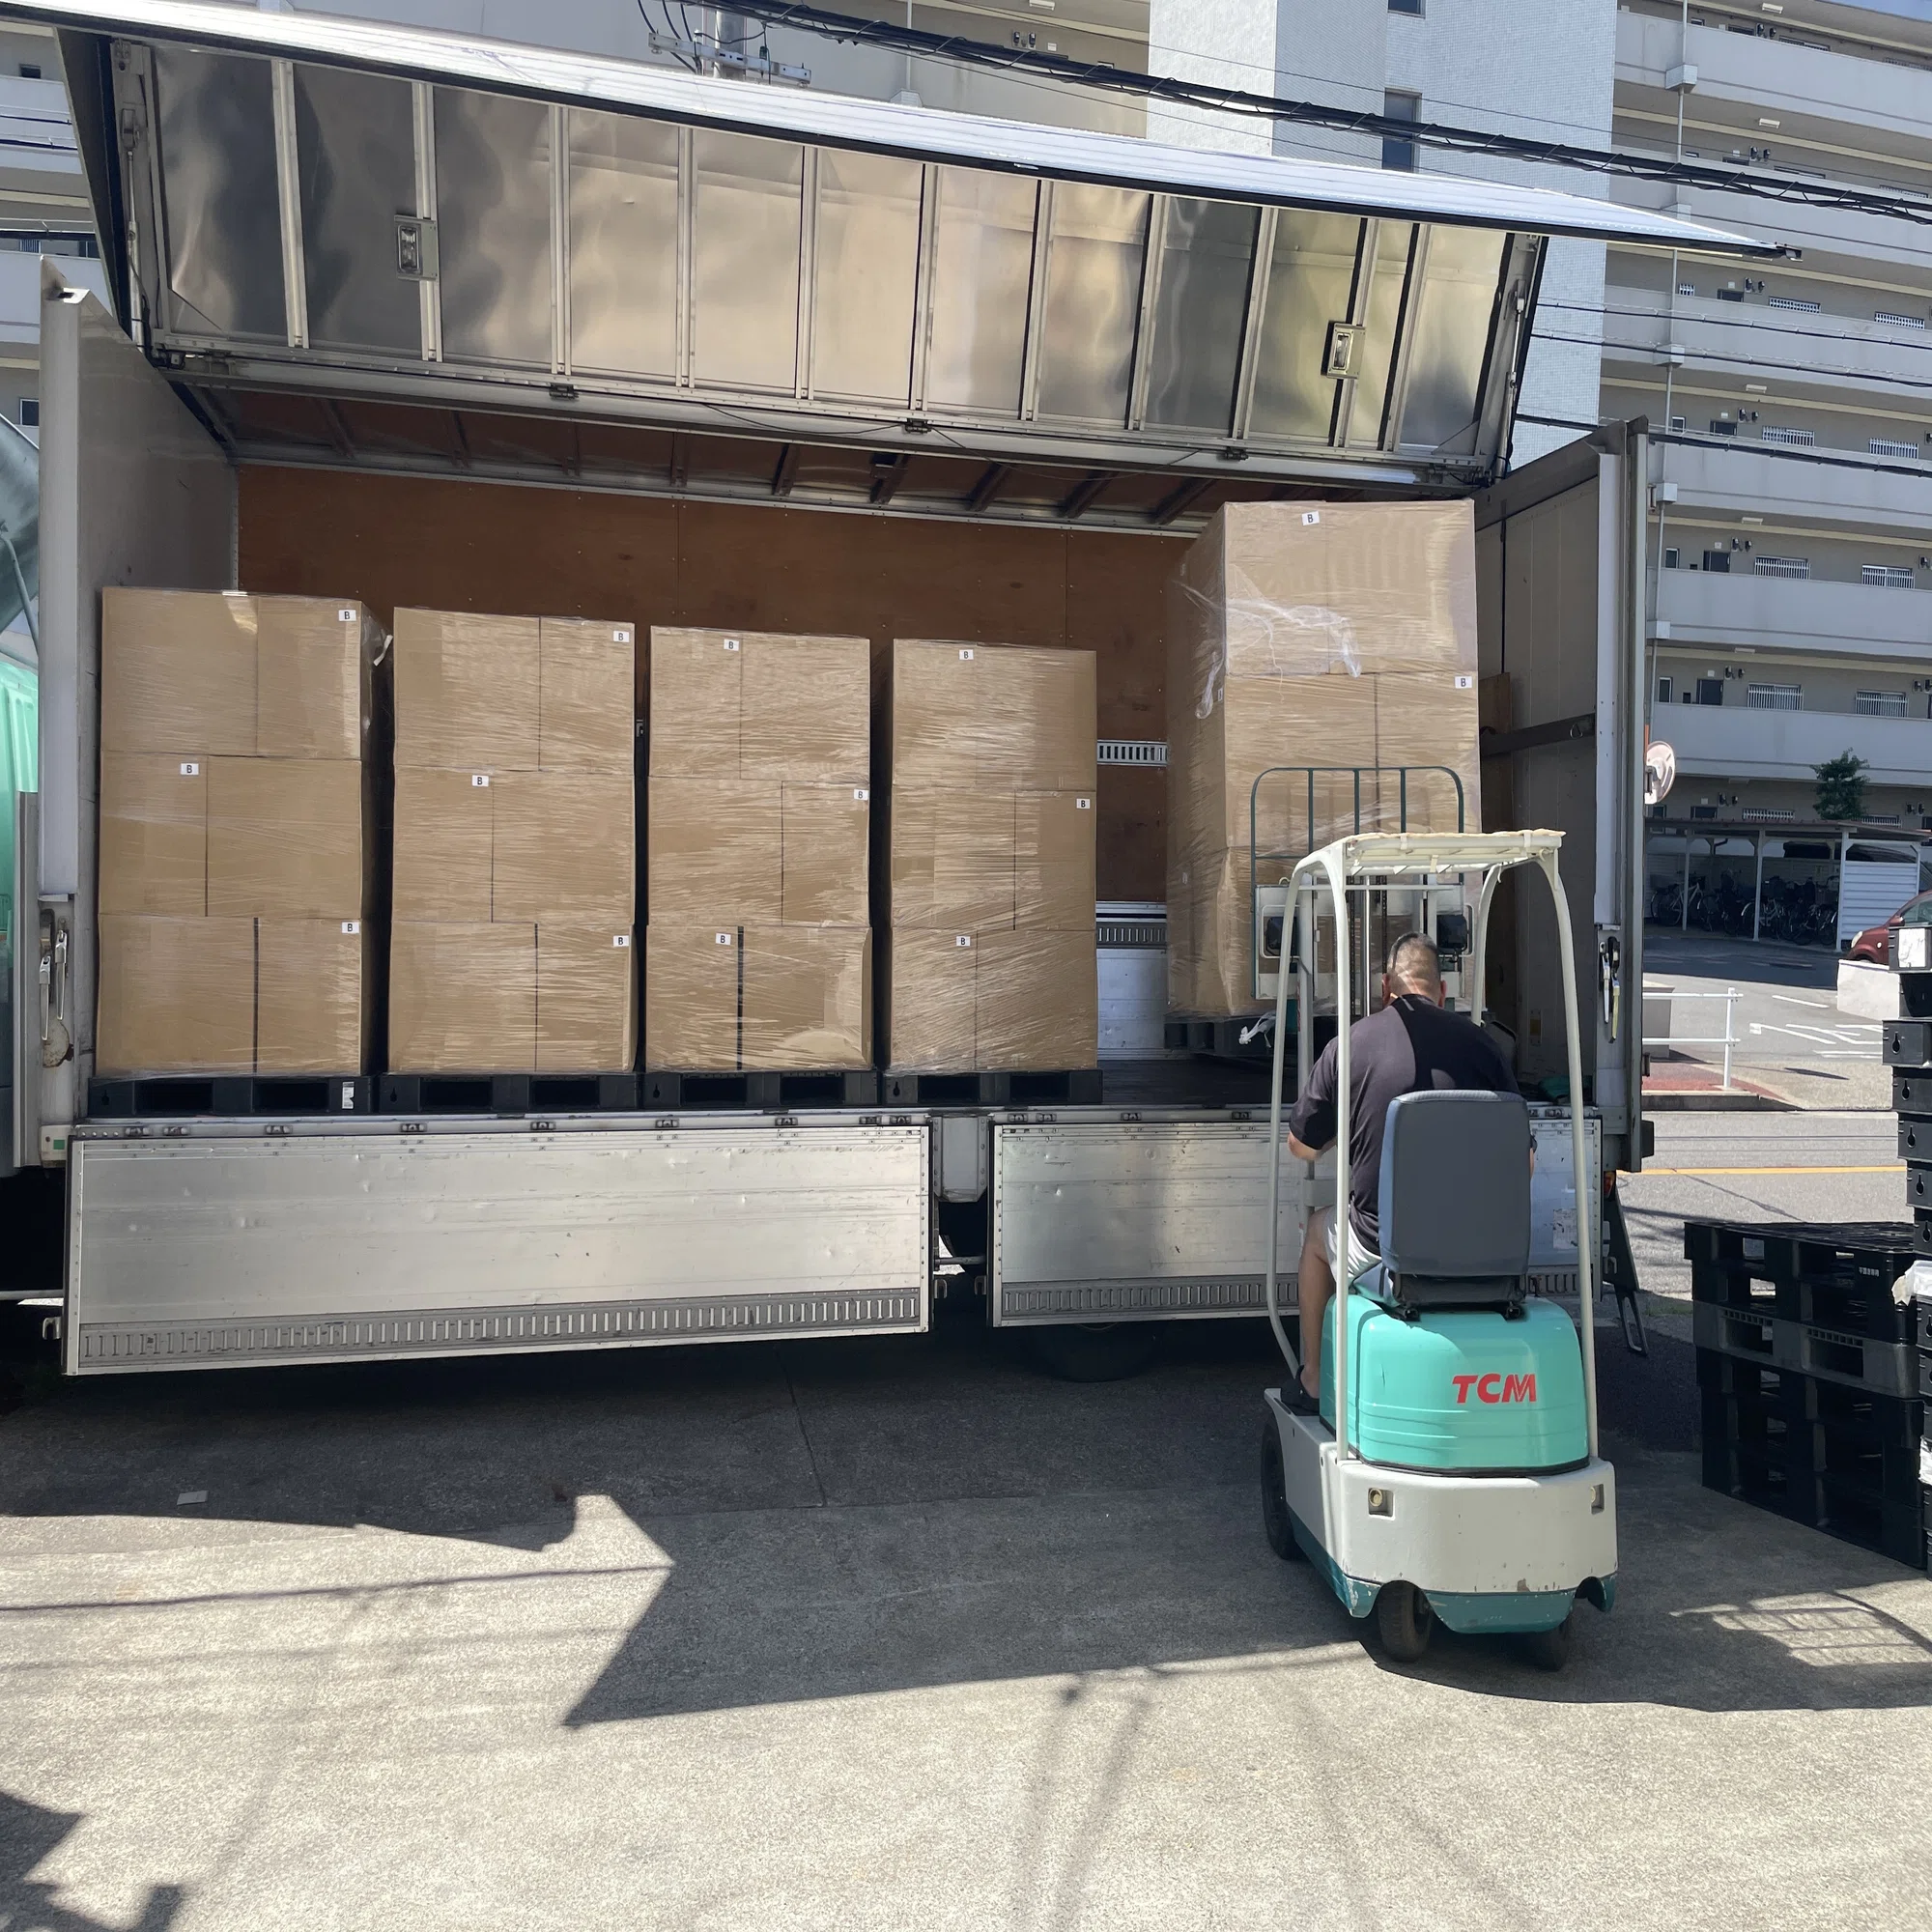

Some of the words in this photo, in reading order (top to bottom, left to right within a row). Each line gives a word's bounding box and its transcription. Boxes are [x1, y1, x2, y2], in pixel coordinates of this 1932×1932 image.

[1307, 513, 1314, 524] B
[344, 611, 351, 620] B
[617, 632, 624, 641] B
[728, 640, 734, 650] B
[963, 650, 969, 660] B
[1460, 677, 1466, 688] B
[186, 764, 193, 774] B
[476, 776, 483, 785] B
[858, 790, 864, 800] B
[1080, 799, 1086, 809] B
[347, 923, 354, 932] B
[617, 936, 624, 946] B
[720, 934, 725, 944] B
[960, 937, 966, 946] B
[1452, 1373, 1537, 1404] TCM
